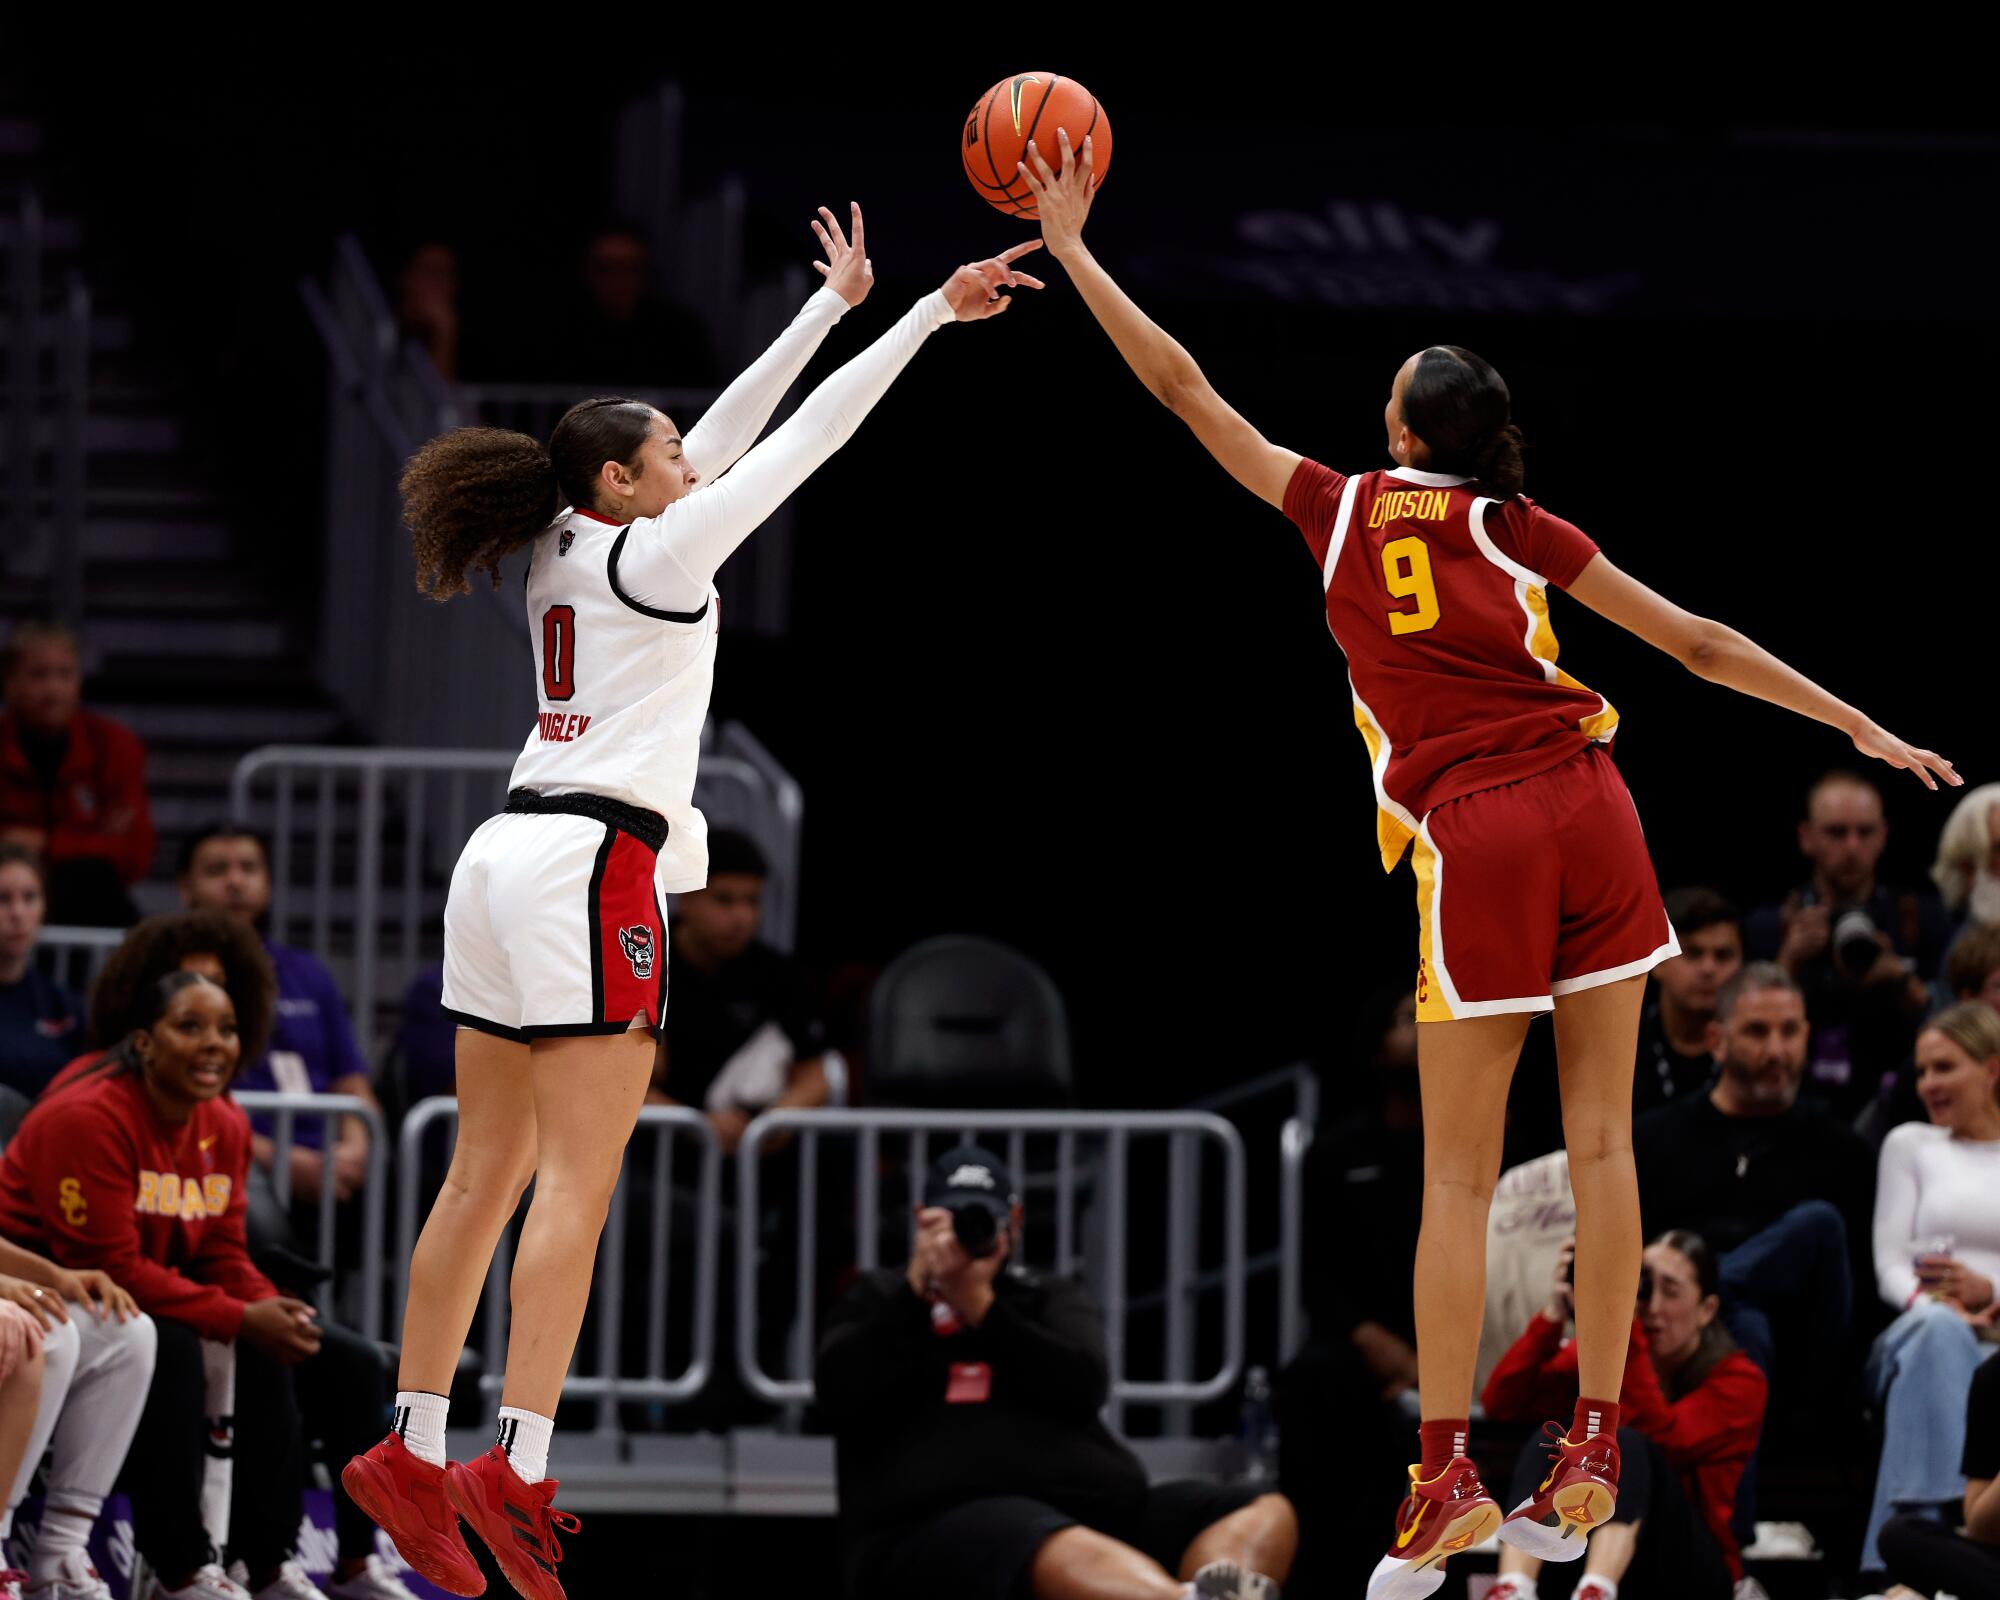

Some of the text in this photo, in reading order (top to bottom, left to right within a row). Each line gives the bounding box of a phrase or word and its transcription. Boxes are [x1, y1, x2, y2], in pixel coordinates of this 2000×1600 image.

[1381, 536, 1440, 635] 9
[542, 604, 576, 701] 0
[538, 713, 591, 742] UIGLEY
